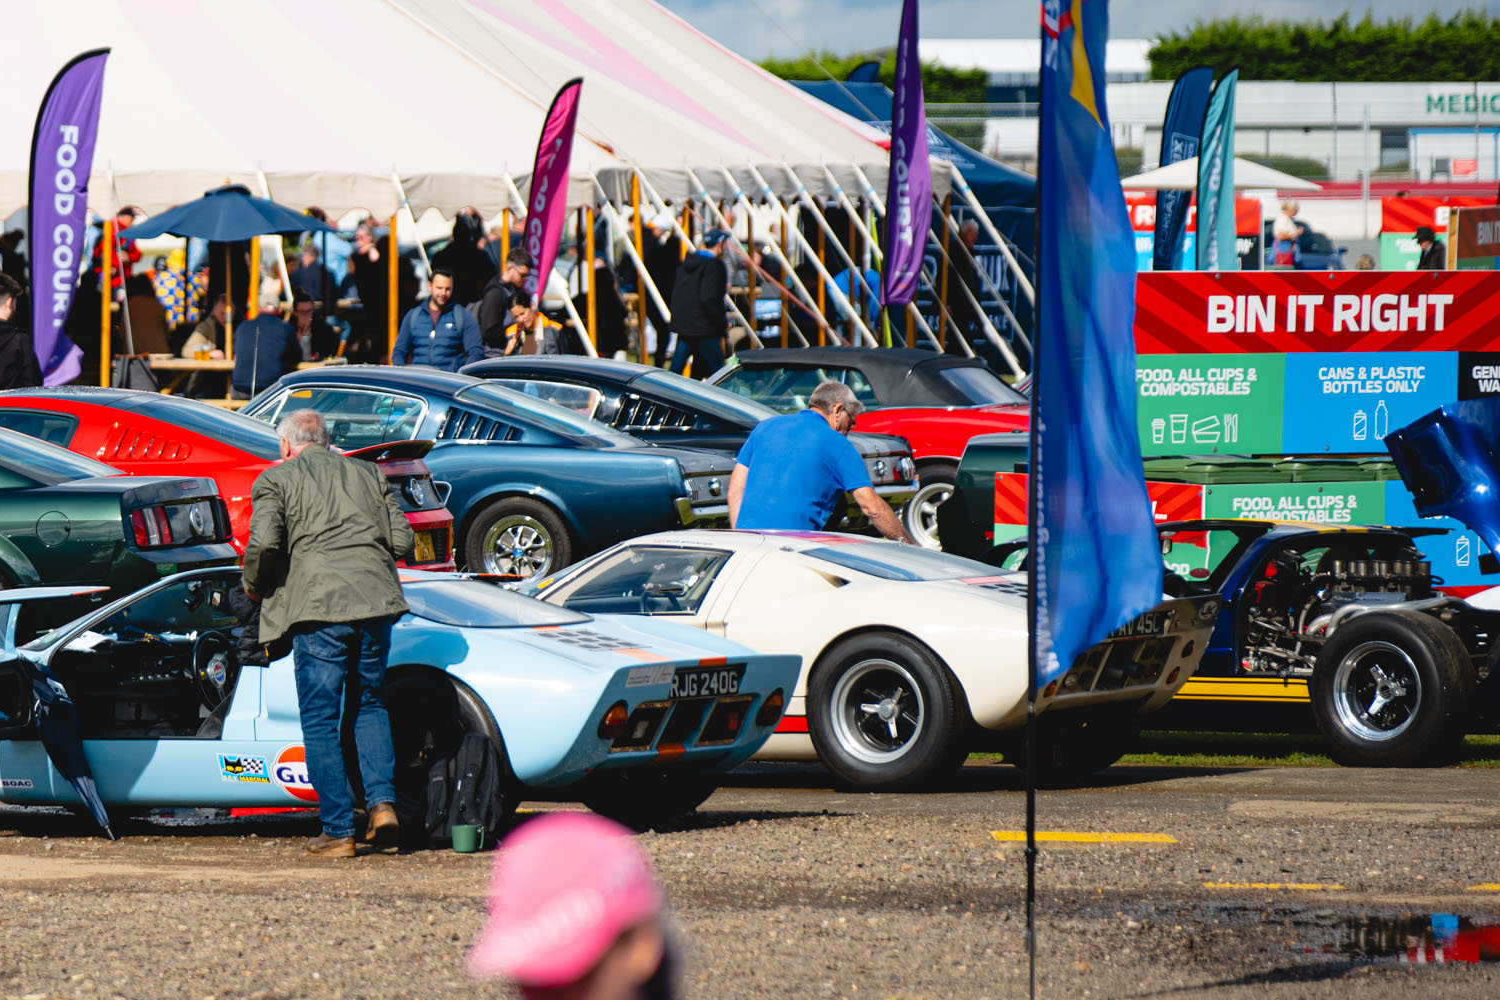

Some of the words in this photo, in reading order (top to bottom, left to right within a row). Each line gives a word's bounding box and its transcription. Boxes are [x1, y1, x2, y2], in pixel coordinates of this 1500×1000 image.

[54, 124, 79, 216] FOOD
[1207, 295, 1276, 333] BIN
[1286, 295, 1324, 332] IT
[1333, 294, 1454, 332] RIGHT
[1135, 369, 1176, 383] FOOD,
[1178, 368, 1204, 382] ALL
[1207, 368, 1244, 382] CUPS
[1247, 367, 1257, 381] &
[1318, 367, 1355, 380] CANS
[1357, 367, 1368, 379] &
[1371, 366, 1426, 379] PLASTIC
[1140, 381, 1251, 396] COMPOSTABLES
[1323, 381, 1382, 394] BOTTLES
[1385, 380, 1420, 393] ONLY
[1233, 498, 1275, 512] FOOD,
[1277, 496, 1304, 510] ALL
[1307, 496, 1344, 509] CUPS
[1347, 495, 1357, 508] &
[1239, 509, 1351, 522] COMPOSTABLES
[670, 673, 698, 698] RJG
[700, 671, 738, 695] 240G
